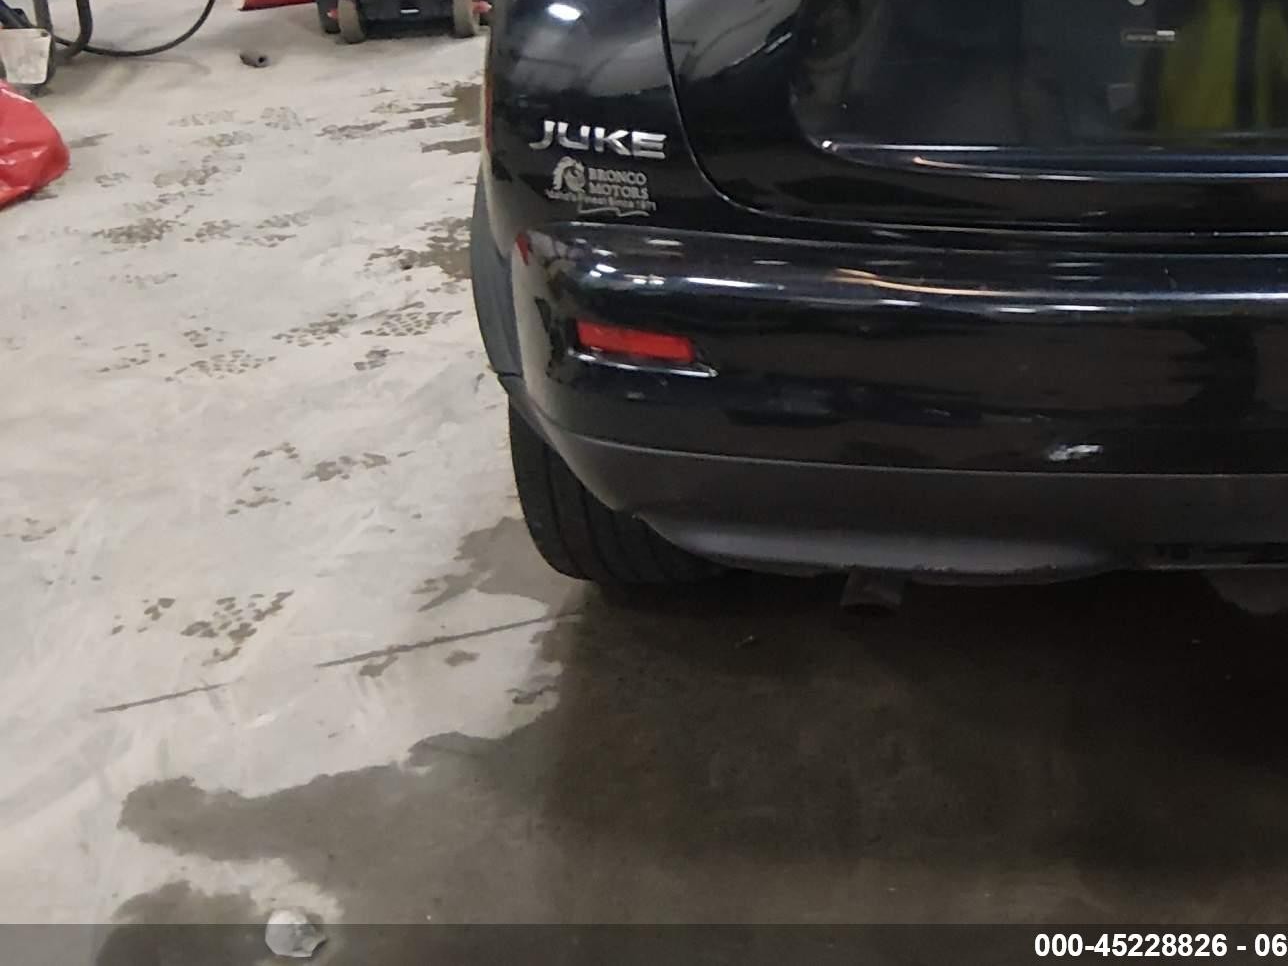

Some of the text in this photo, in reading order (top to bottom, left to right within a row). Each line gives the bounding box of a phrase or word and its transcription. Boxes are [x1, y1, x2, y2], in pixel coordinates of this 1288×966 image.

[529, 120, 667, 160] JUKE
[588, 168, 647, 186] BRONCO
[588, 182, 649, 200] MOTORS
